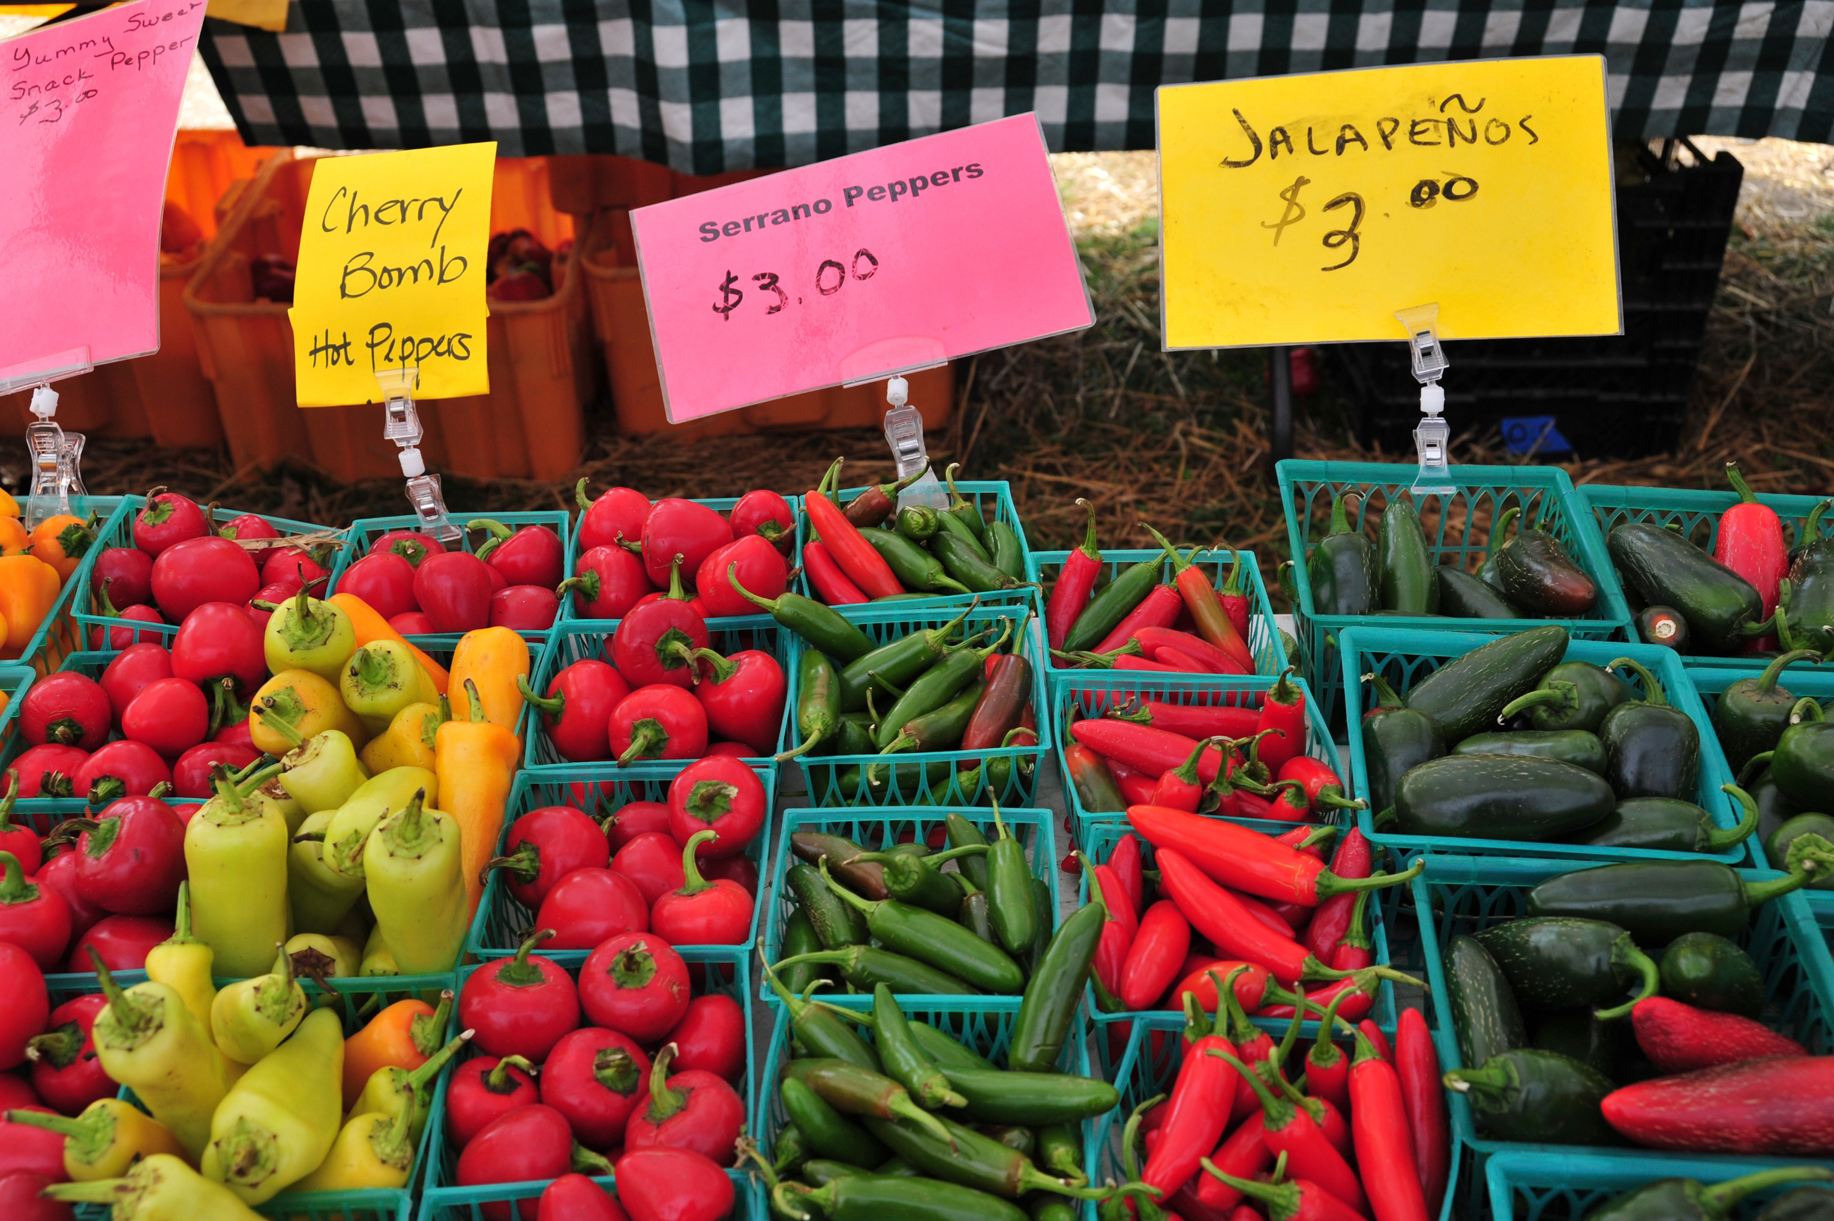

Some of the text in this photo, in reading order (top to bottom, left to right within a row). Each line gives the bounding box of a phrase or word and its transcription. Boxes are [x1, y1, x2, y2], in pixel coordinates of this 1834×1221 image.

[10, 36, 193, 100] Snack Pepper
[12, 2, 203, 71] Yummy Sweet
[19, 89, 98, 126] $3.00
[1219, 93, 1539, 169] JALAPEÑOS
[321, 186, 463, 249] Cherry
[698, 161, 985, 243] Serrano Peppers
[1260, 170, 1480, 272] $3.00
[339, 245, 468, 300] Bomb
[711, 247, 879, 321] $3.00
[309, 322, 473, 390] Hot Peppers
